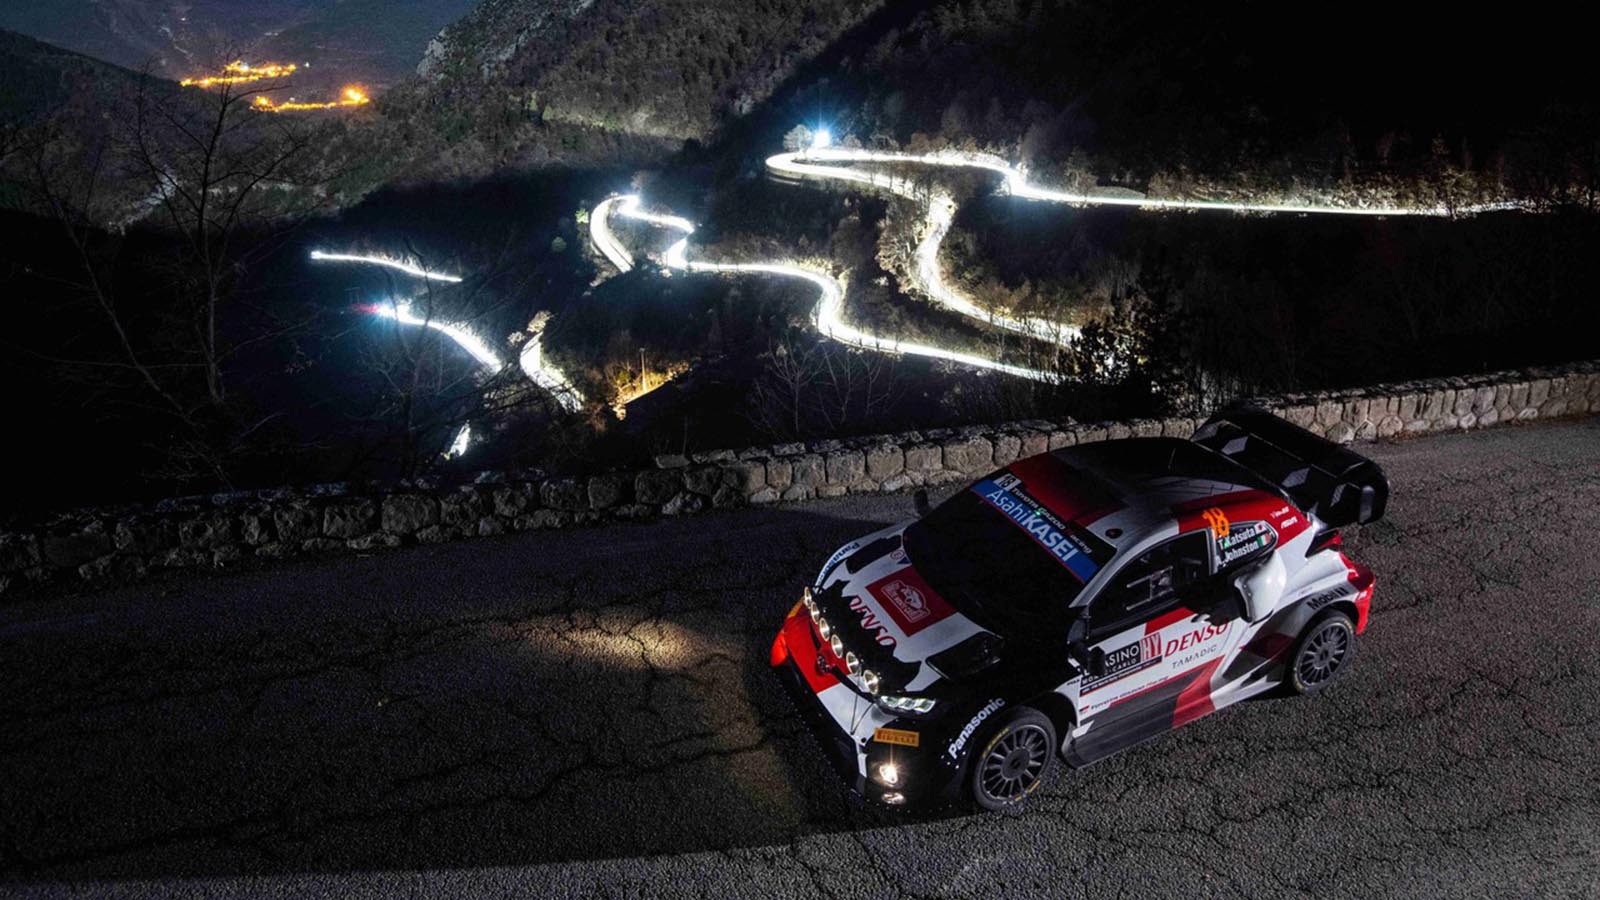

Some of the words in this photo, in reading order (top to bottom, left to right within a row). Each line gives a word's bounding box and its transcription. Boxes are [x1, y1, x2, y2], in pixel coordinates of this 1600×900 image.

[1202, 507, 1230, 540] 18
[1164, 622, 1229, 657] DENSO
[948, 698, 1006, 759] Panasonic
